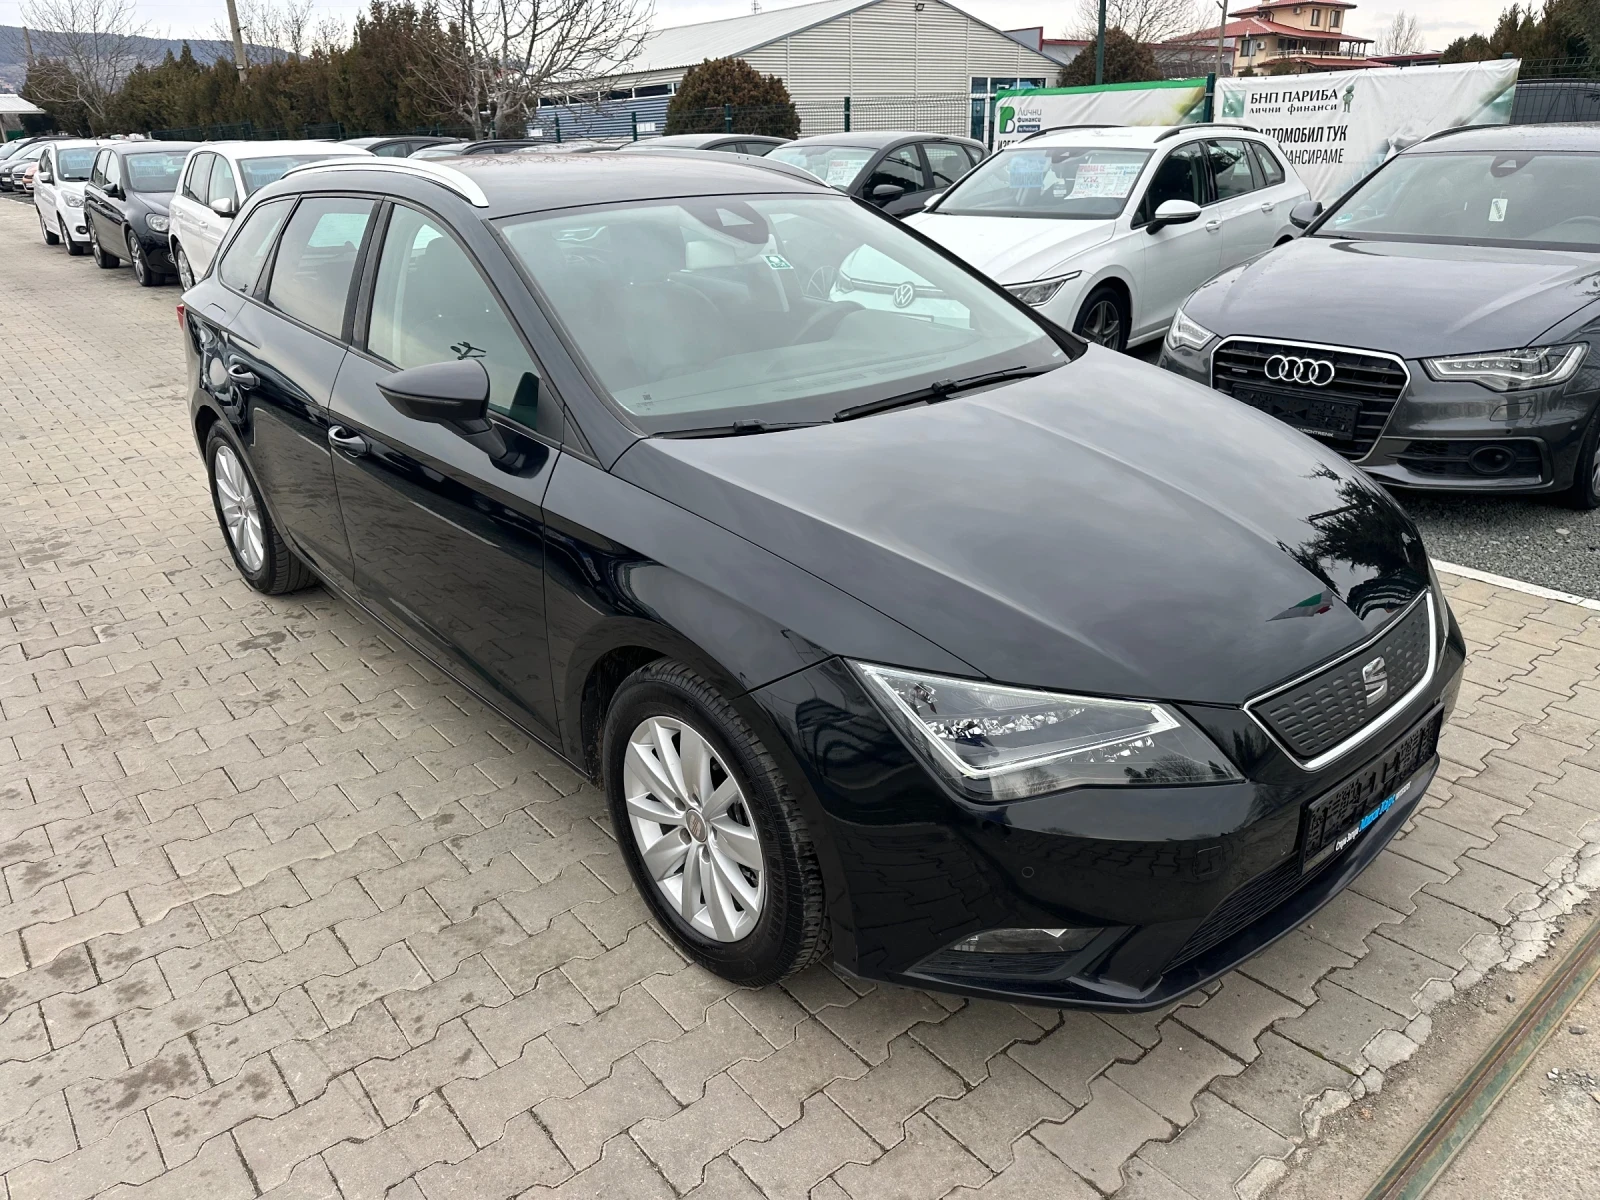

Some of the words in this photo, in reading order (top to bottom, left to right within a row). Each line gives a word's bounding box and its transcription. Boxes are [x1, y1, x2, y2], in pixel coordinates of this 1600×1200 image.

[1250, 91, 1279, 105] БНП
[1282, 88, 1339, 103] ПАРИБА
[1287, 103, 1337, 116] финанси
[1326, 124, 1348, 142] ТУК
[1285, 148, 1345, 165] АНСИРАМЕ
[1297, 427, 1334, 438] ARCHTRENK
